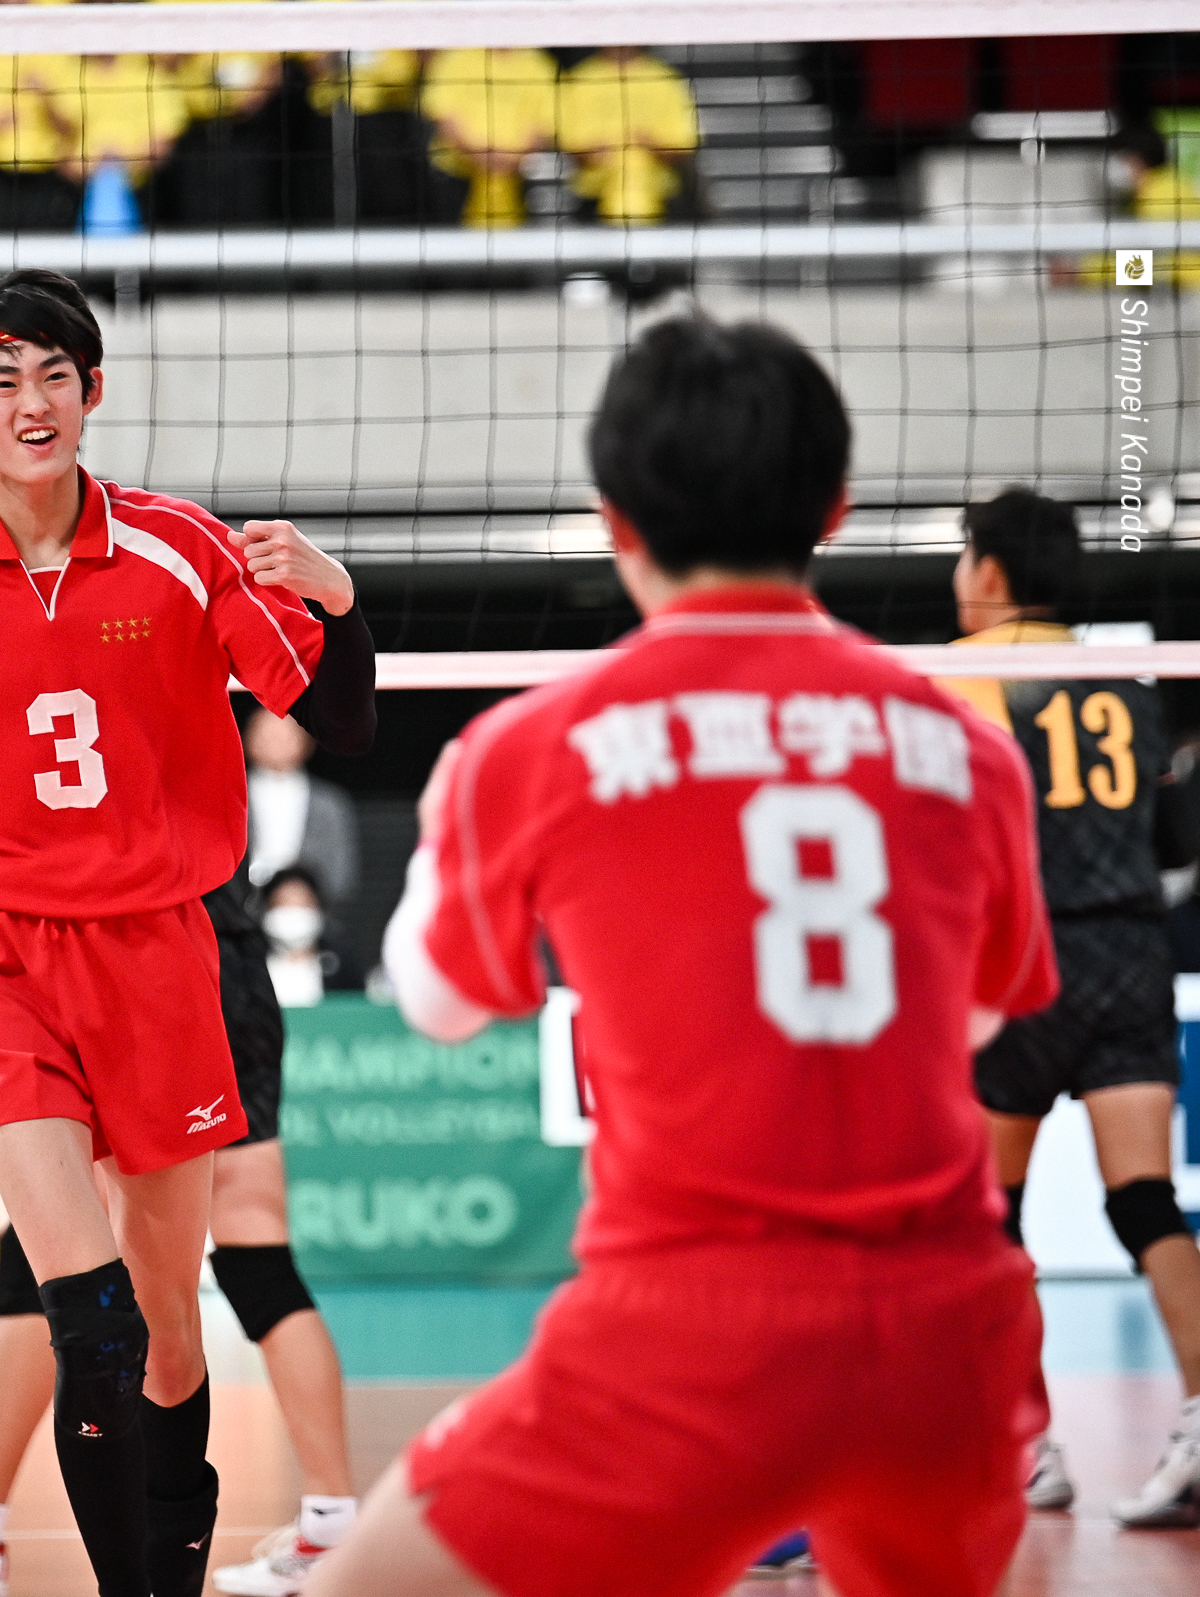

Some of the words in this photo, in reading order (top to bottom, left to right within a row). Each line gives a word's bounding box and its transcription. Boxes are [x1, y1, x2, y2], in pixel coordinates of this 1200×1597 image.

[26, 688, 108, 810] 3
[1034, 690, 1138, 809] 13
[739, 782, 897, 1048] 8
